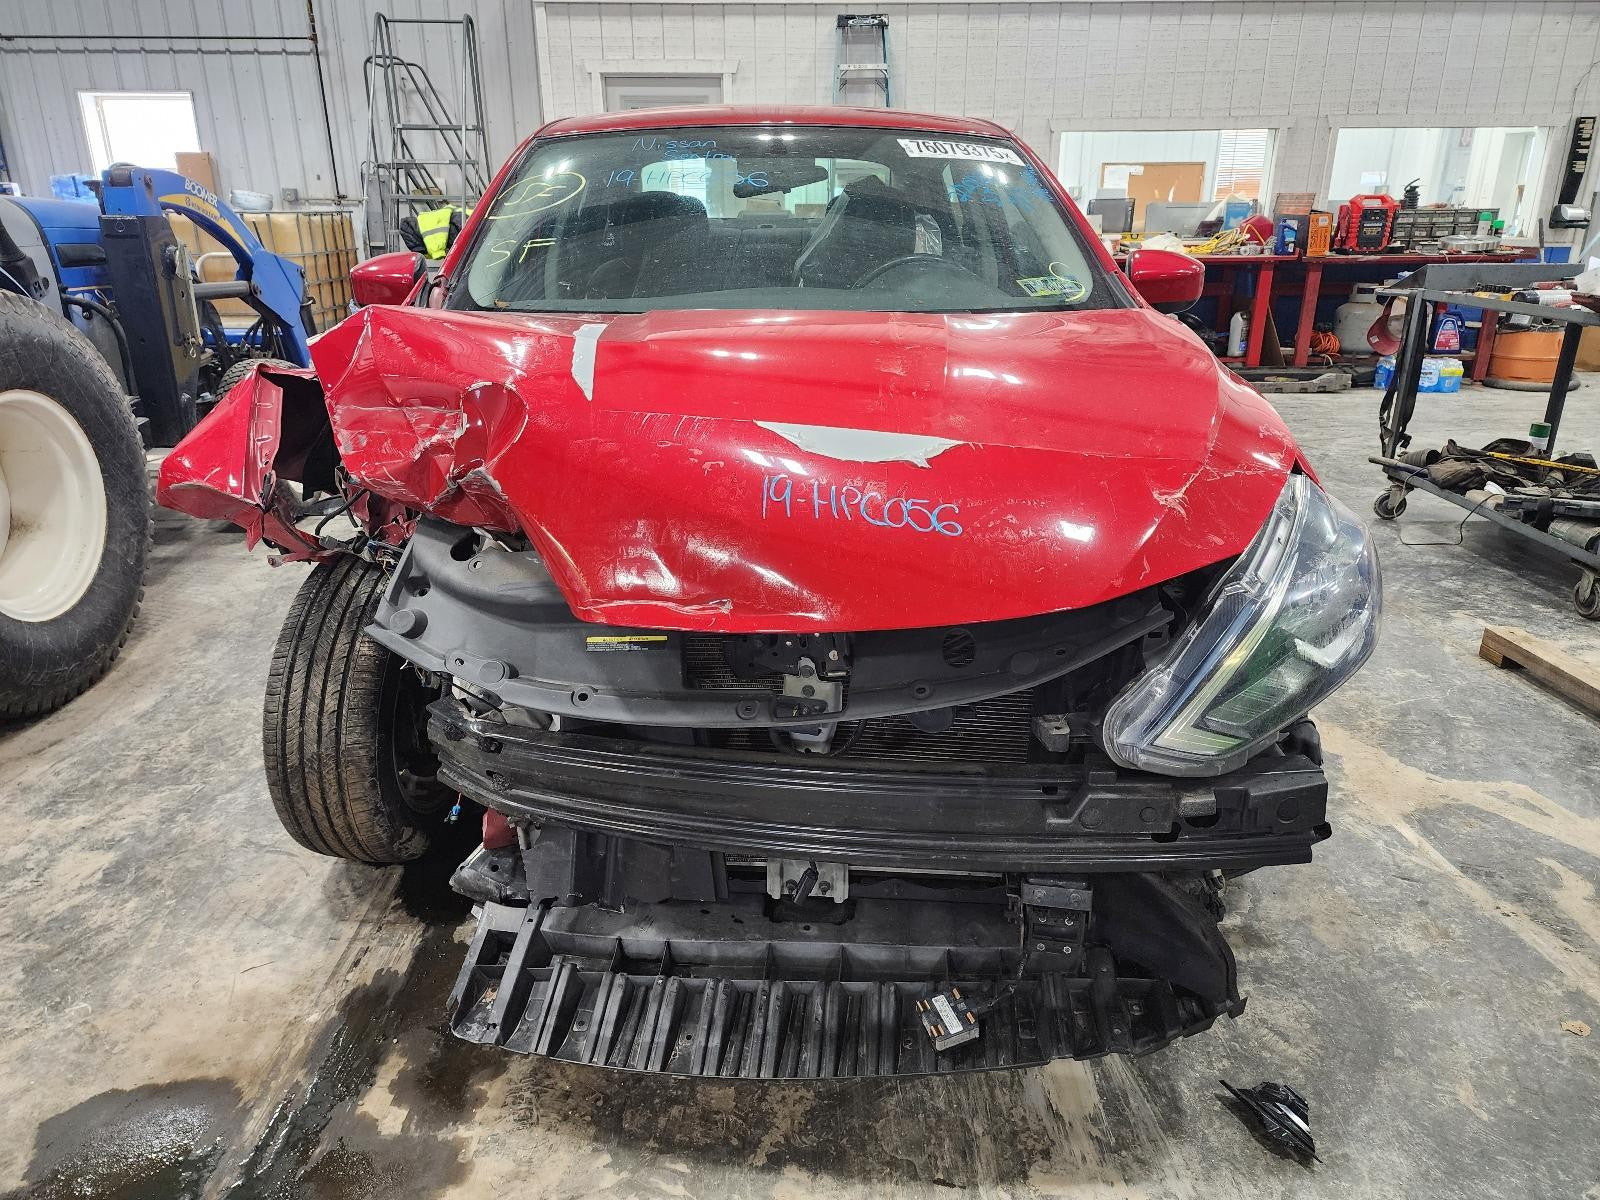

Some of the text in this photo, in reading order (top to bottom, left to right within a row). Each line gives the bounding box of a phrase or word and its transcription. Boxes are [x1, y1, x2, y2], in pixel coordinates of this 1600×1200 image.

[632, 138, 717, 152] Nissan
[908, 140, 1005, 159] 76079375
[606, 169, 769, 188] 19-HPC6
[184, 177, 218, 208] BOOMER
[761, 474, 963, 537] 19-HPC056
